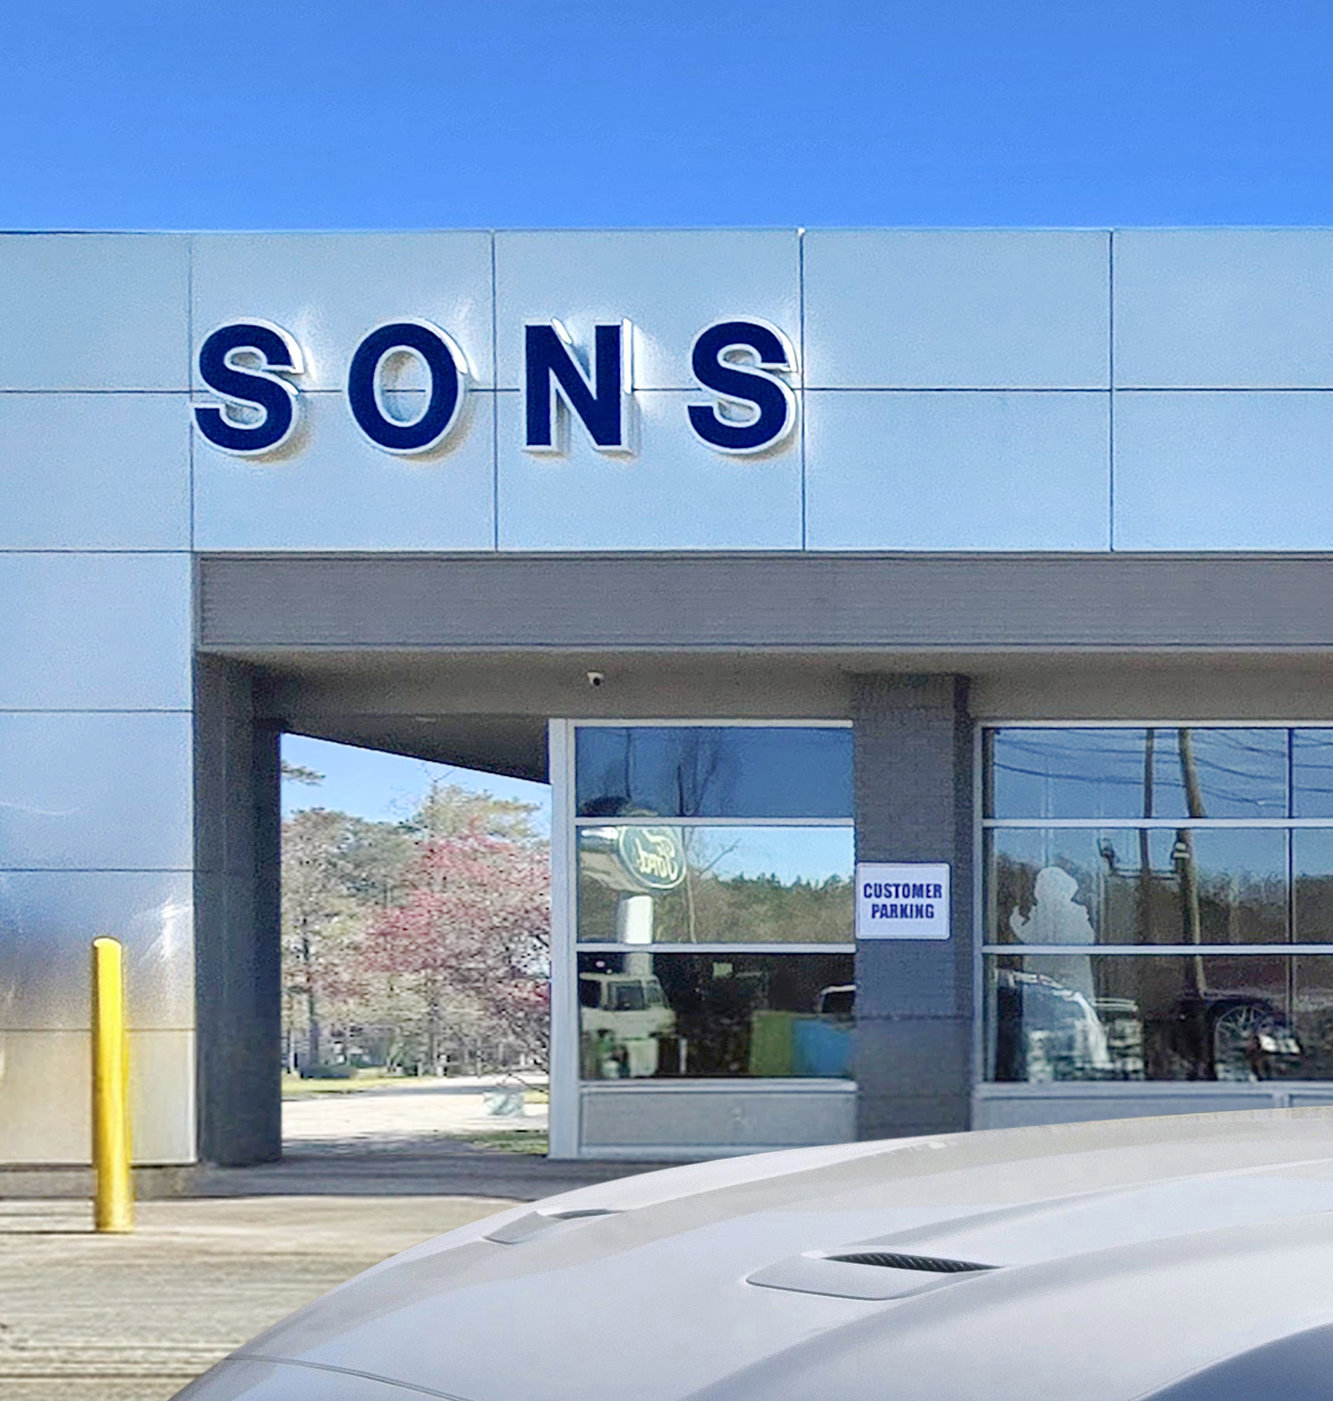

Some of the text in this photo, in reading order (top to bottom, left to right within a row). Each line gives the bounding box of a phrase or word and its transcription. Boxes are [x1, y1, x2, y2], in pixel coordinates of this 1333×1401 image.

[194, 320, 794, 452] SONS
[863, 882, 943, 899] CUSTOMER
[870, 903, 935, 919] PARKING
